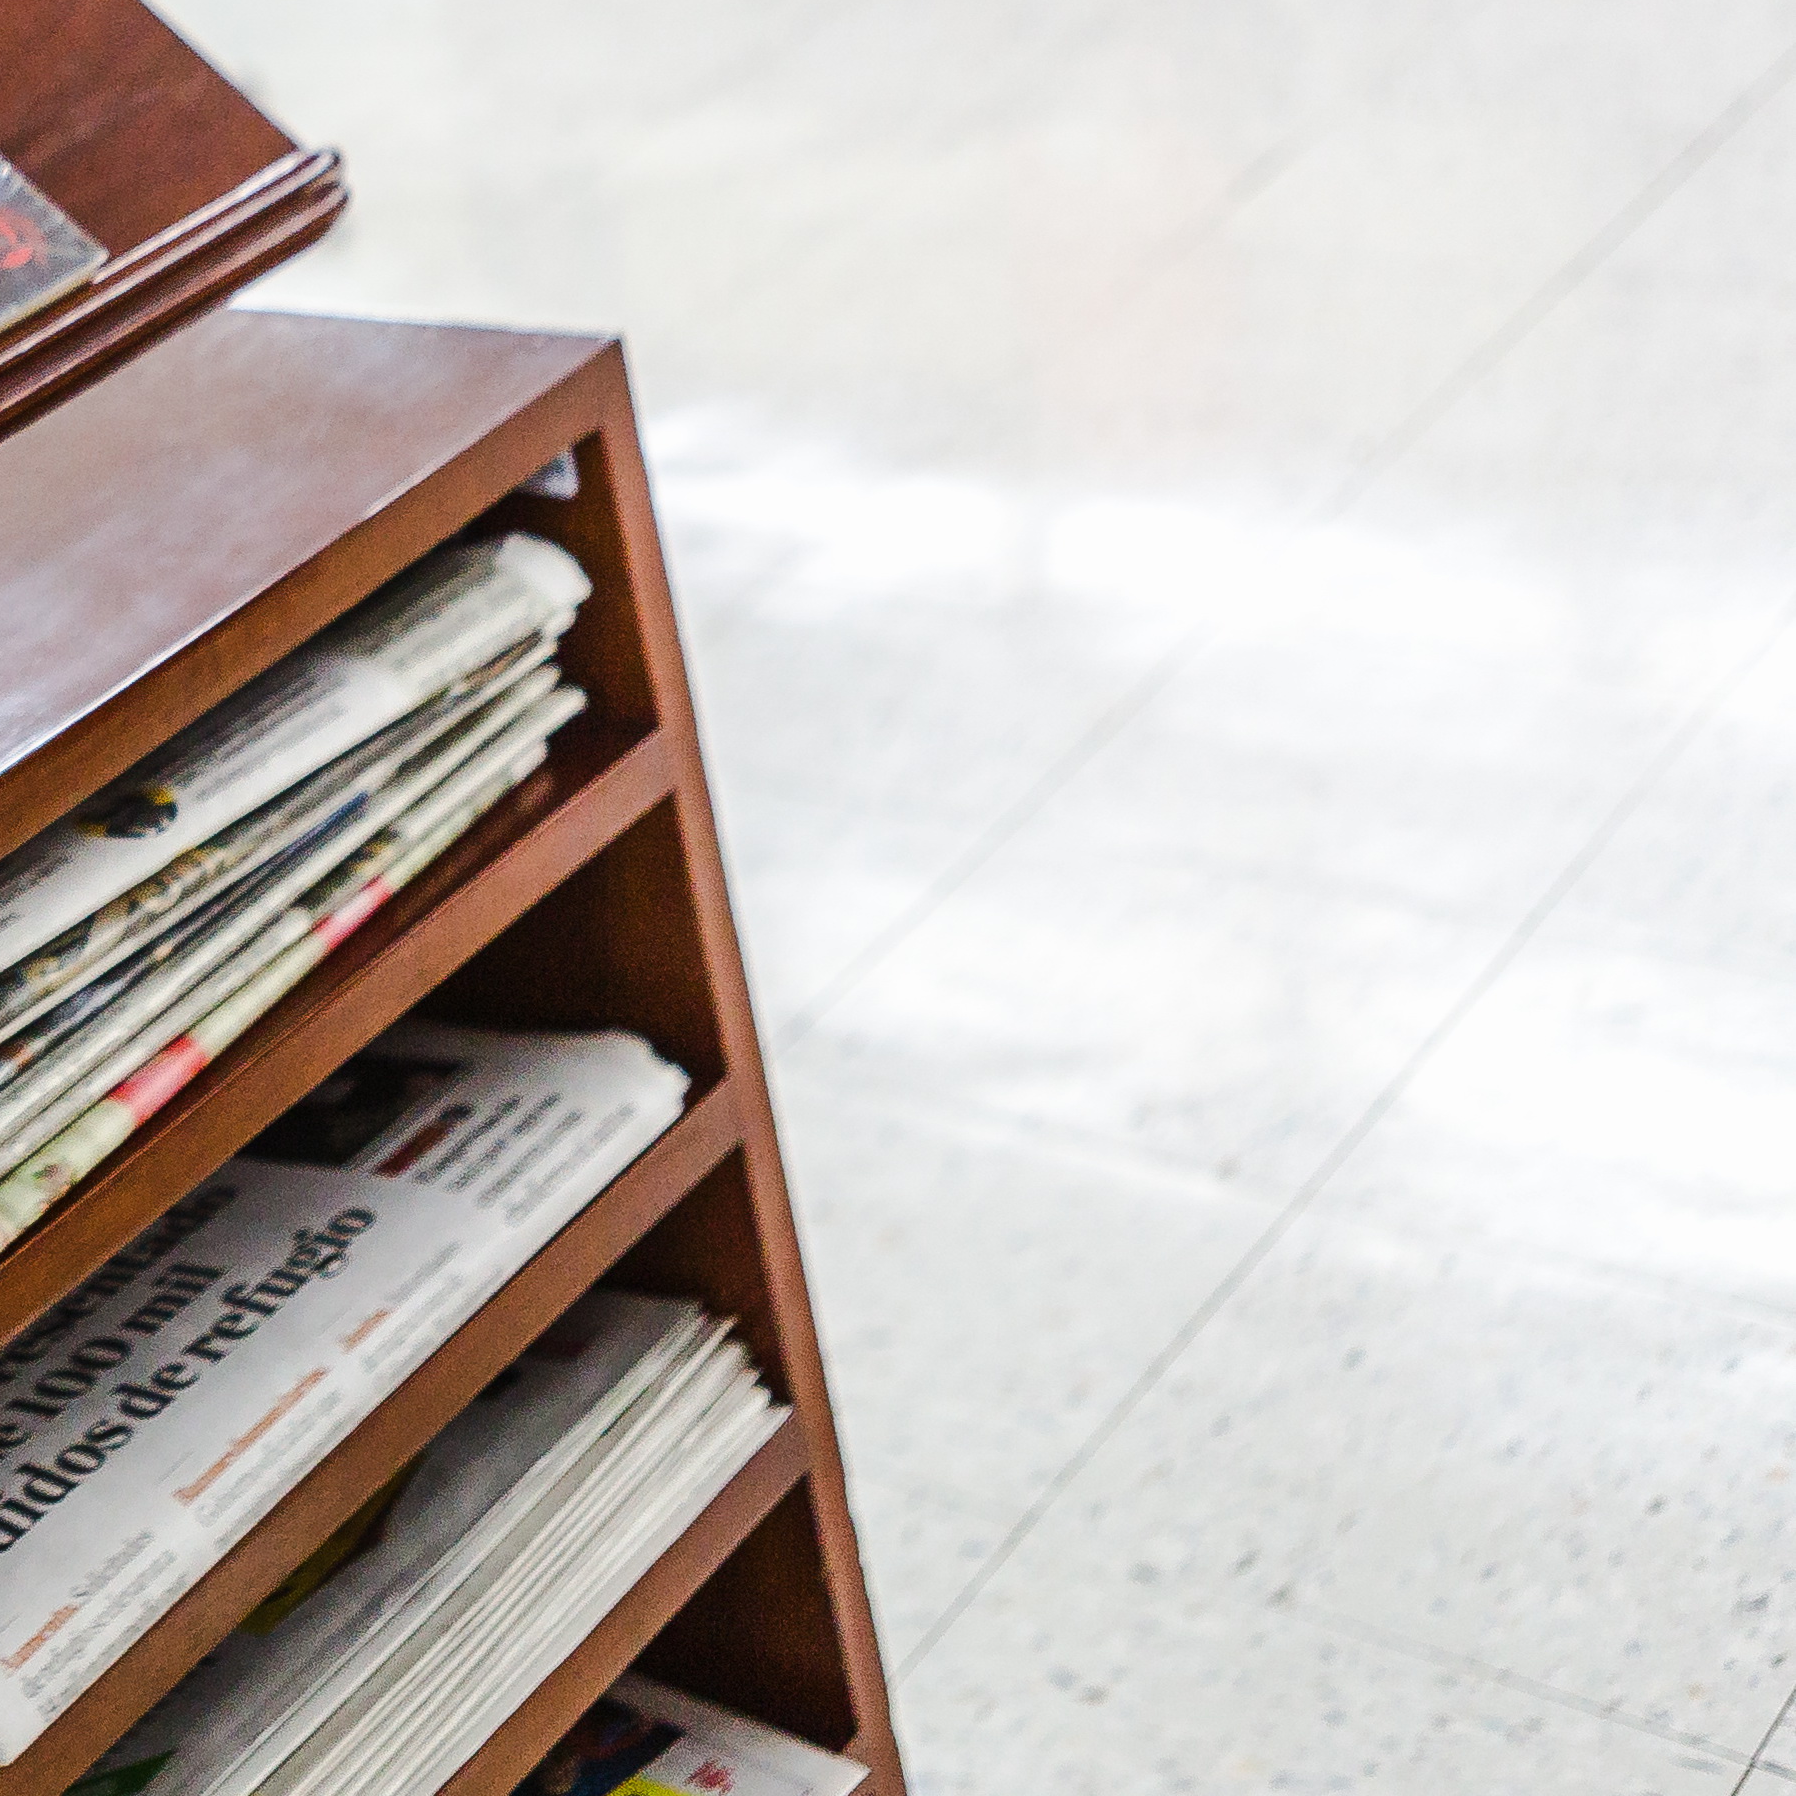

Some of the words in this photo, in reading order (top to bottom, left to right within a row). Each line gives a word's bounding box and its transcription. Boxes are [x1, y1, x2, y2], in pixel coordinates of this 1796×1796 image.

[22, 1333, 133, 1421] 100
[122, 1257, 229, 1337] mil
[115, 1358, 202, 1423] de
[192, 1205, 380, 1368] refugio
